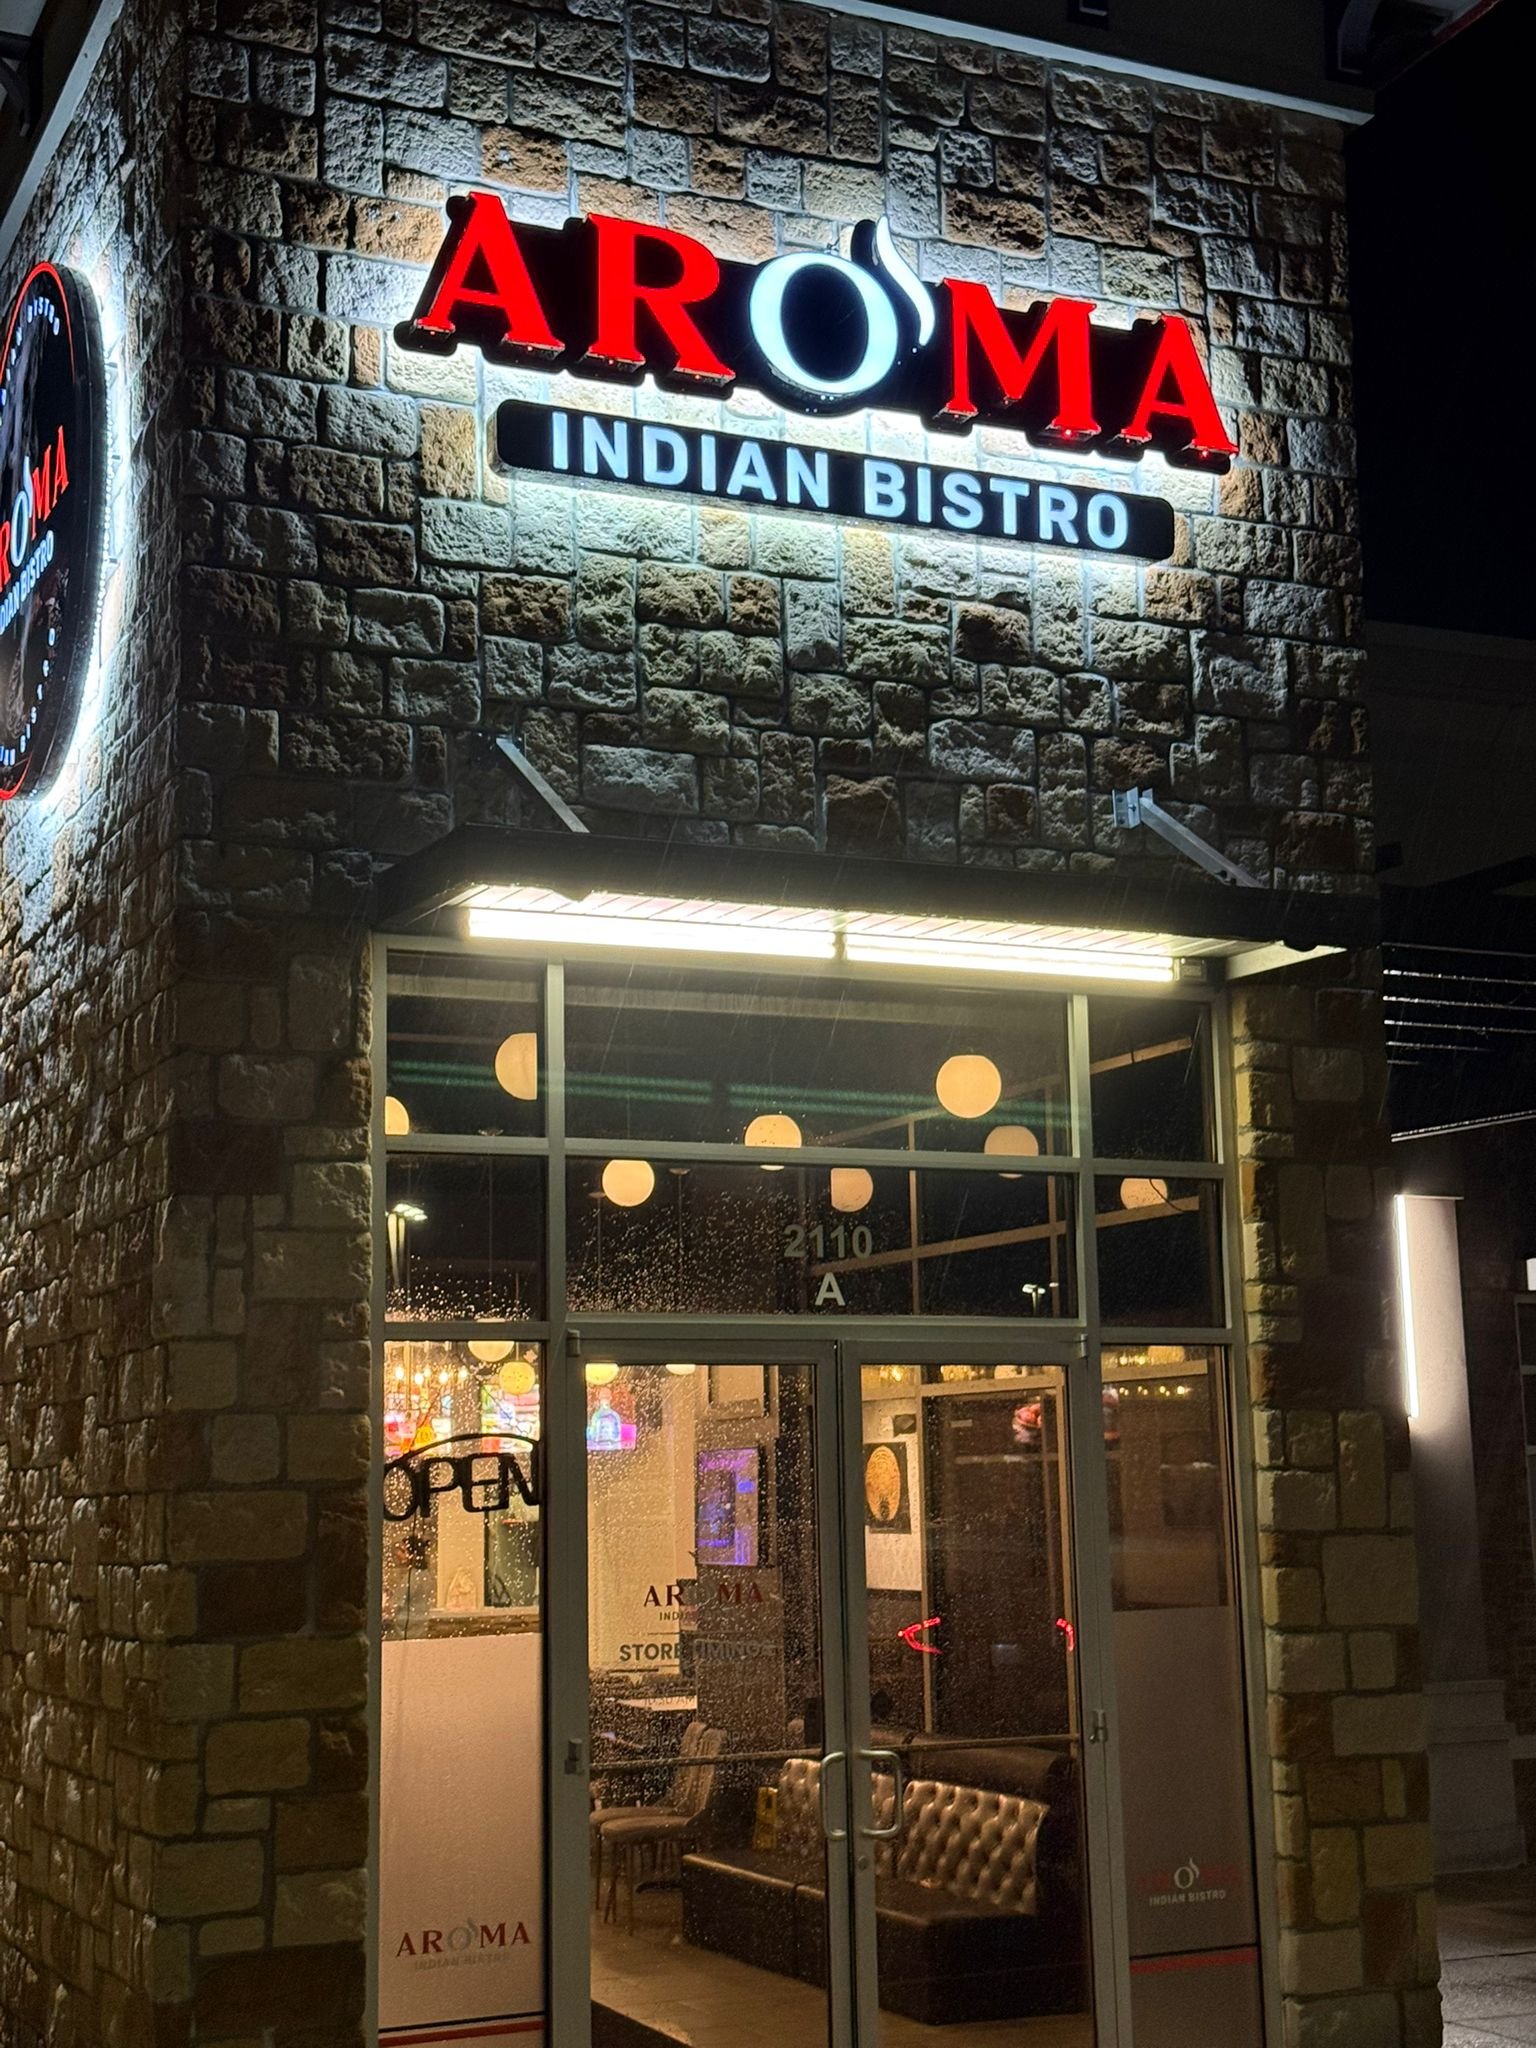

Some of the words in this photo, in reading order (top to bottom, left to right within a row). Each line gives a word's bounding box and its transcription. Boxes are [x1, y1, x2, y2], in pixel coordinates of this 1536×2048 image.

[415, 191, 1239, 457] AROMA
[551, 411, 829, 509] INDIAN
[864, 459, 1129, 549] BISTRO
[20, 529, 54, 602] BISTRO
[783, 1224, 873, 1259] 2110
[814, 1271, 846, 1306] A
[384, 1452, 542, 1522] OPEN
[1148, 1891, 1185, 1908] INDIAN
[1188, 1888, 1228, 1903] BISTRO
[395, 1917, 531, 1959] AROMA
